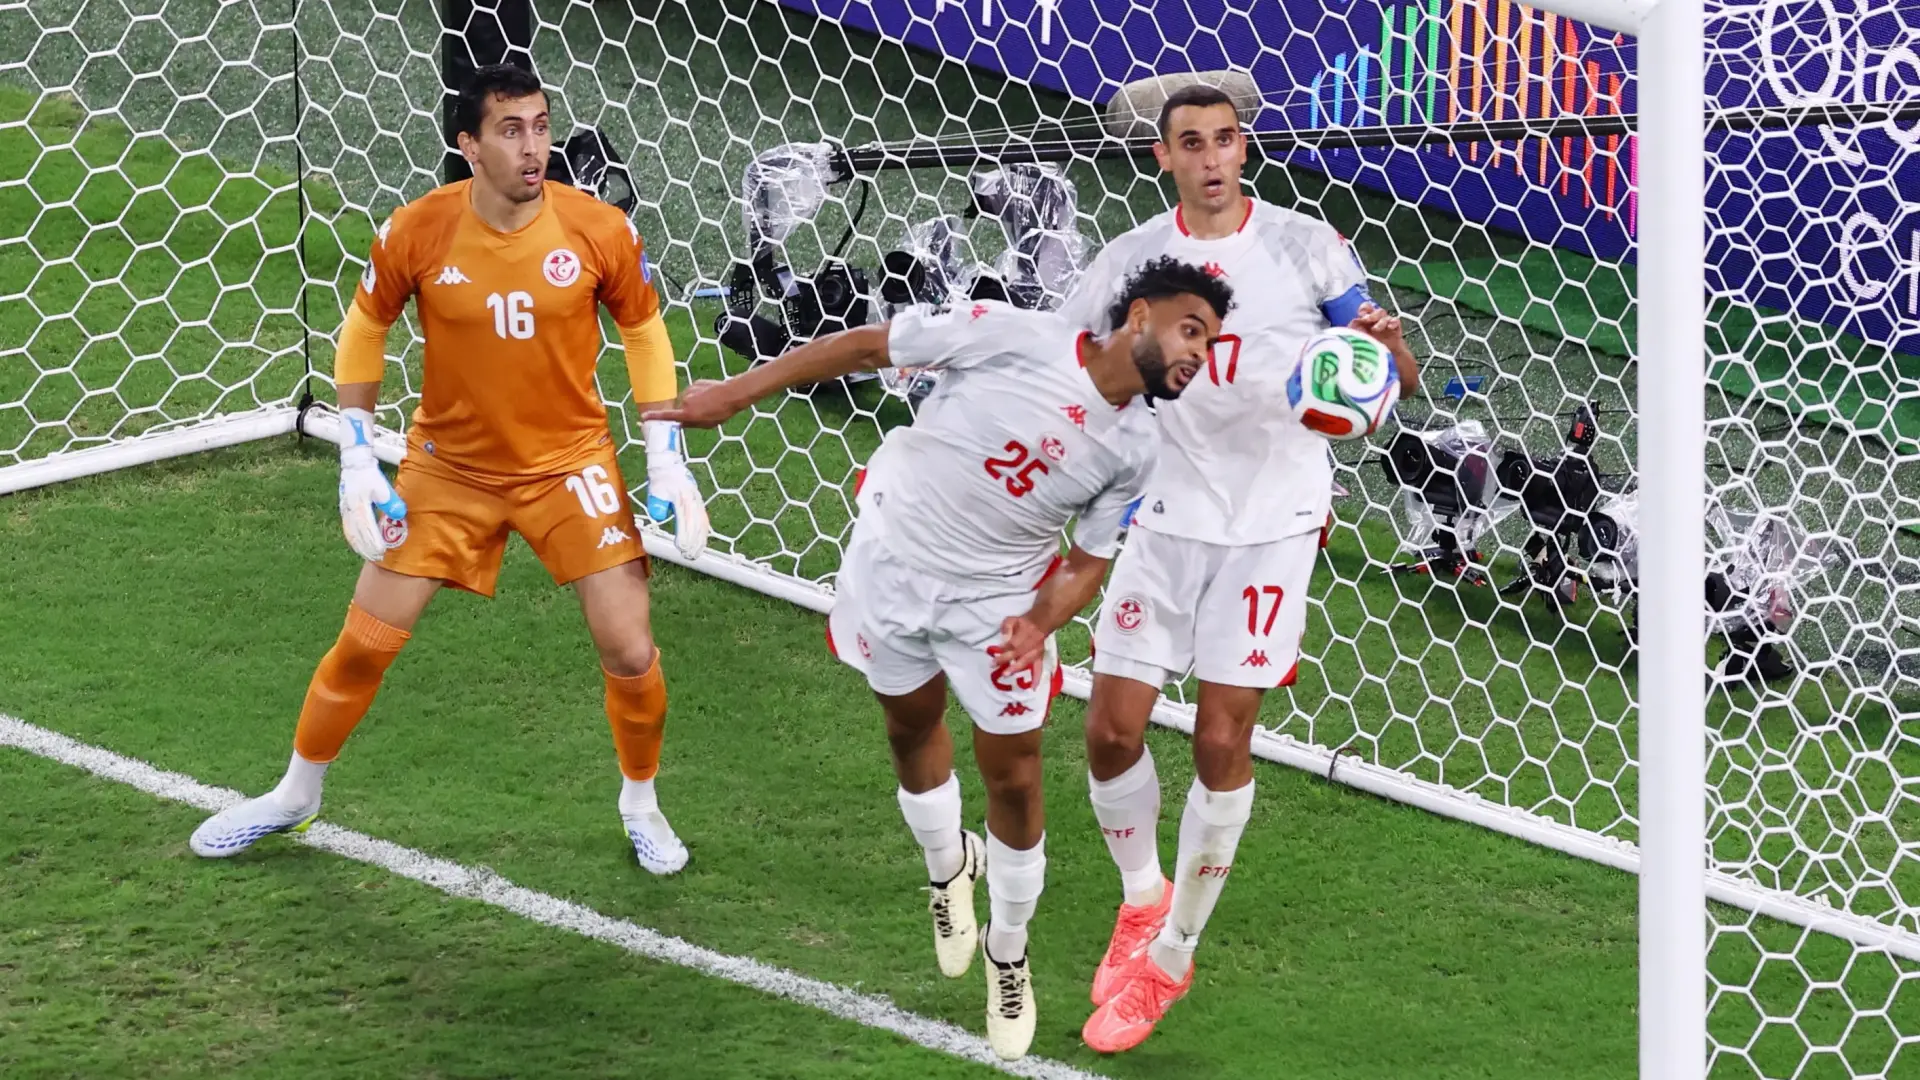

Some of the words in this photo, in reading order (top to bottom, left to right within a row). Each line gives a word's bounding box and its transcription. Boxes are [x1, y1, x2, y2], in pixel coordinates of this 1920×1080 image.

[486, 291, 535, 340] 16
[565, 464, 620, 519] 16
[984, 440, 1049, 498] 25
[1242, 584, 1284, 637] 17
